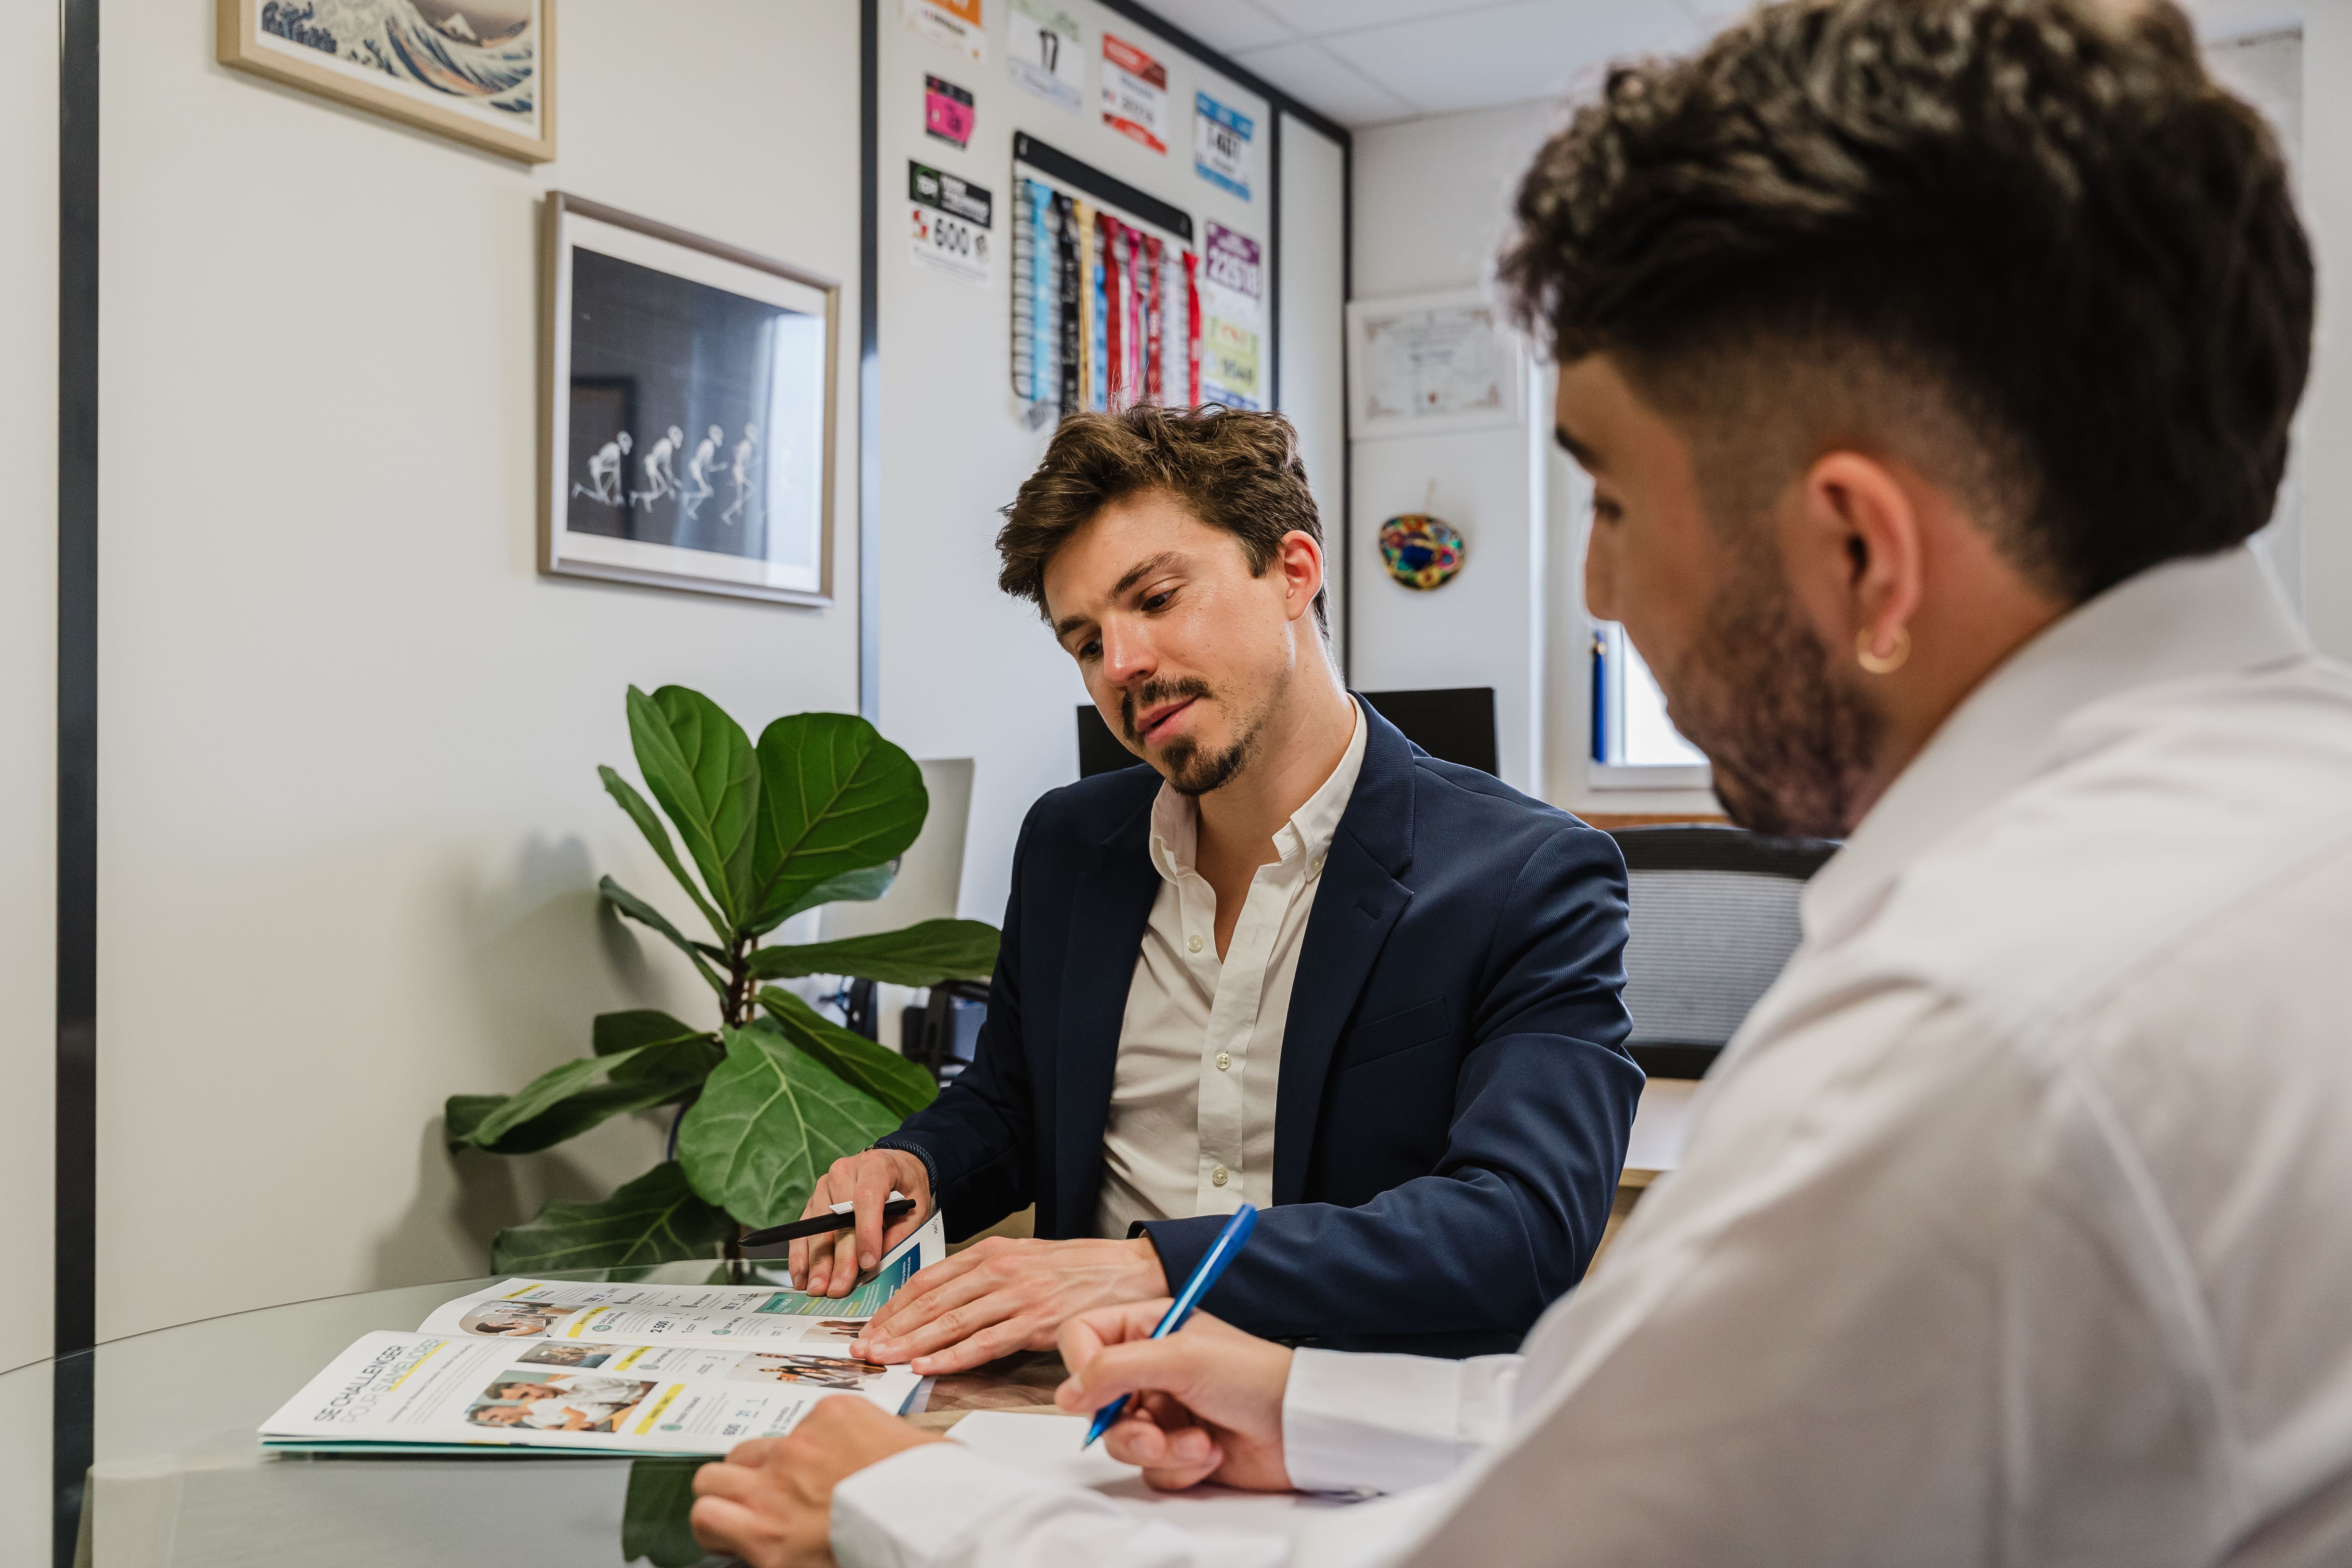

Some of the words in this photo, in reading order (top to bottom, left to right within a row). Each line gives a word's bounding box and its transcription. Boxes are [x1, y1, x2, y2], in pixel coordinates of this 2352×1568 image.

[1039, 30, 1059, 74] 17
[935, 218, 969, 256] 600
[653, 1320, 670, 1329] 500
[331, 1345, 409, 1407] CHALLENGER
[314, 1407, 350, 1423] SE
